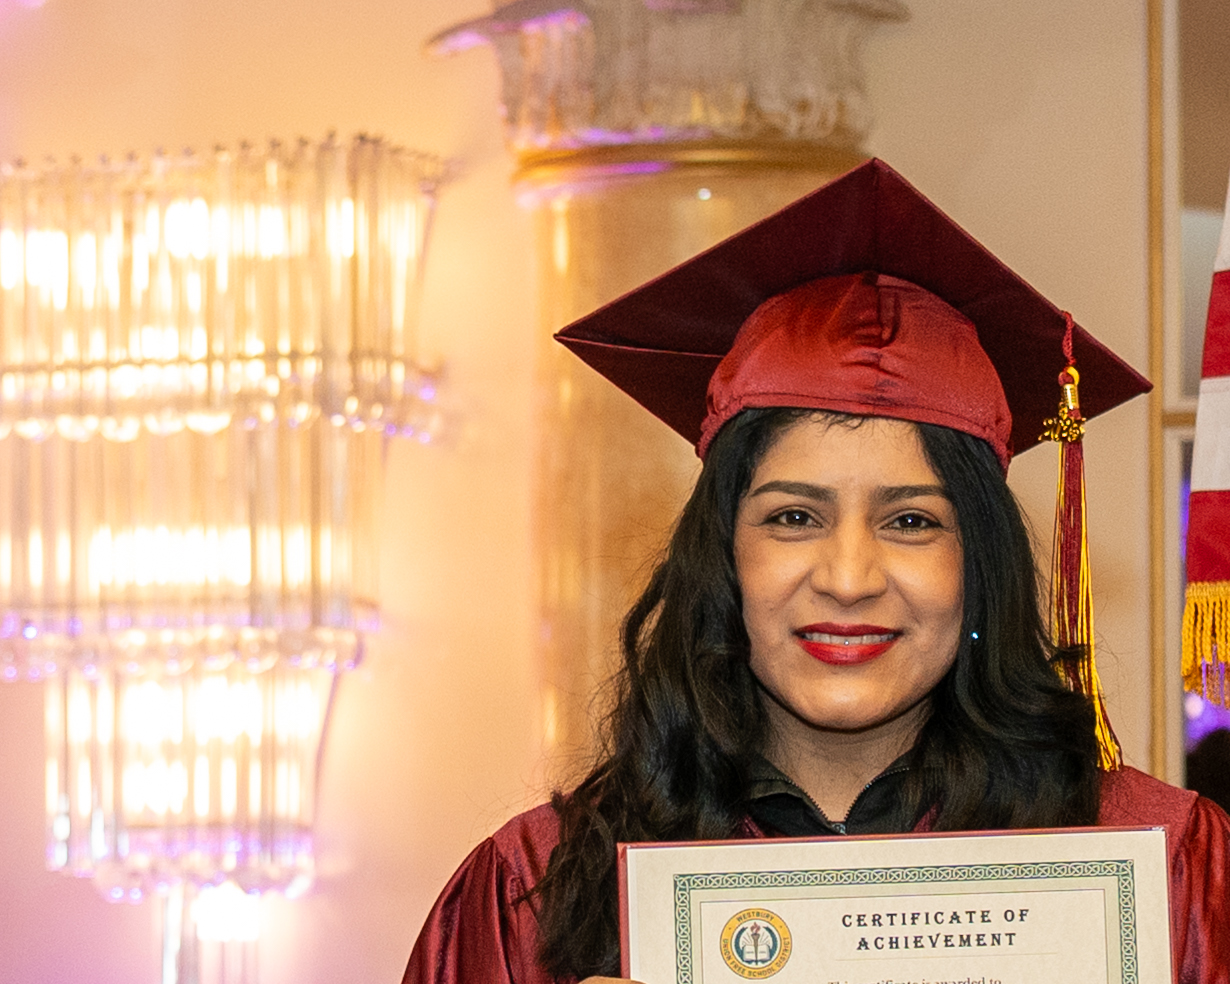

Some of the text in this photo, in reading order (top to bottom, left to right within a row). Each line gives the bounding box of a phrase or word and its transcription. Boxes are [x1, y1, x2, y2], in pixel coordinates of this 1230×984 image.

[841, 908, 1030, 928] CERTIFICATE OF
[856, 933, 1017, 951] ACHIEVEMENT
